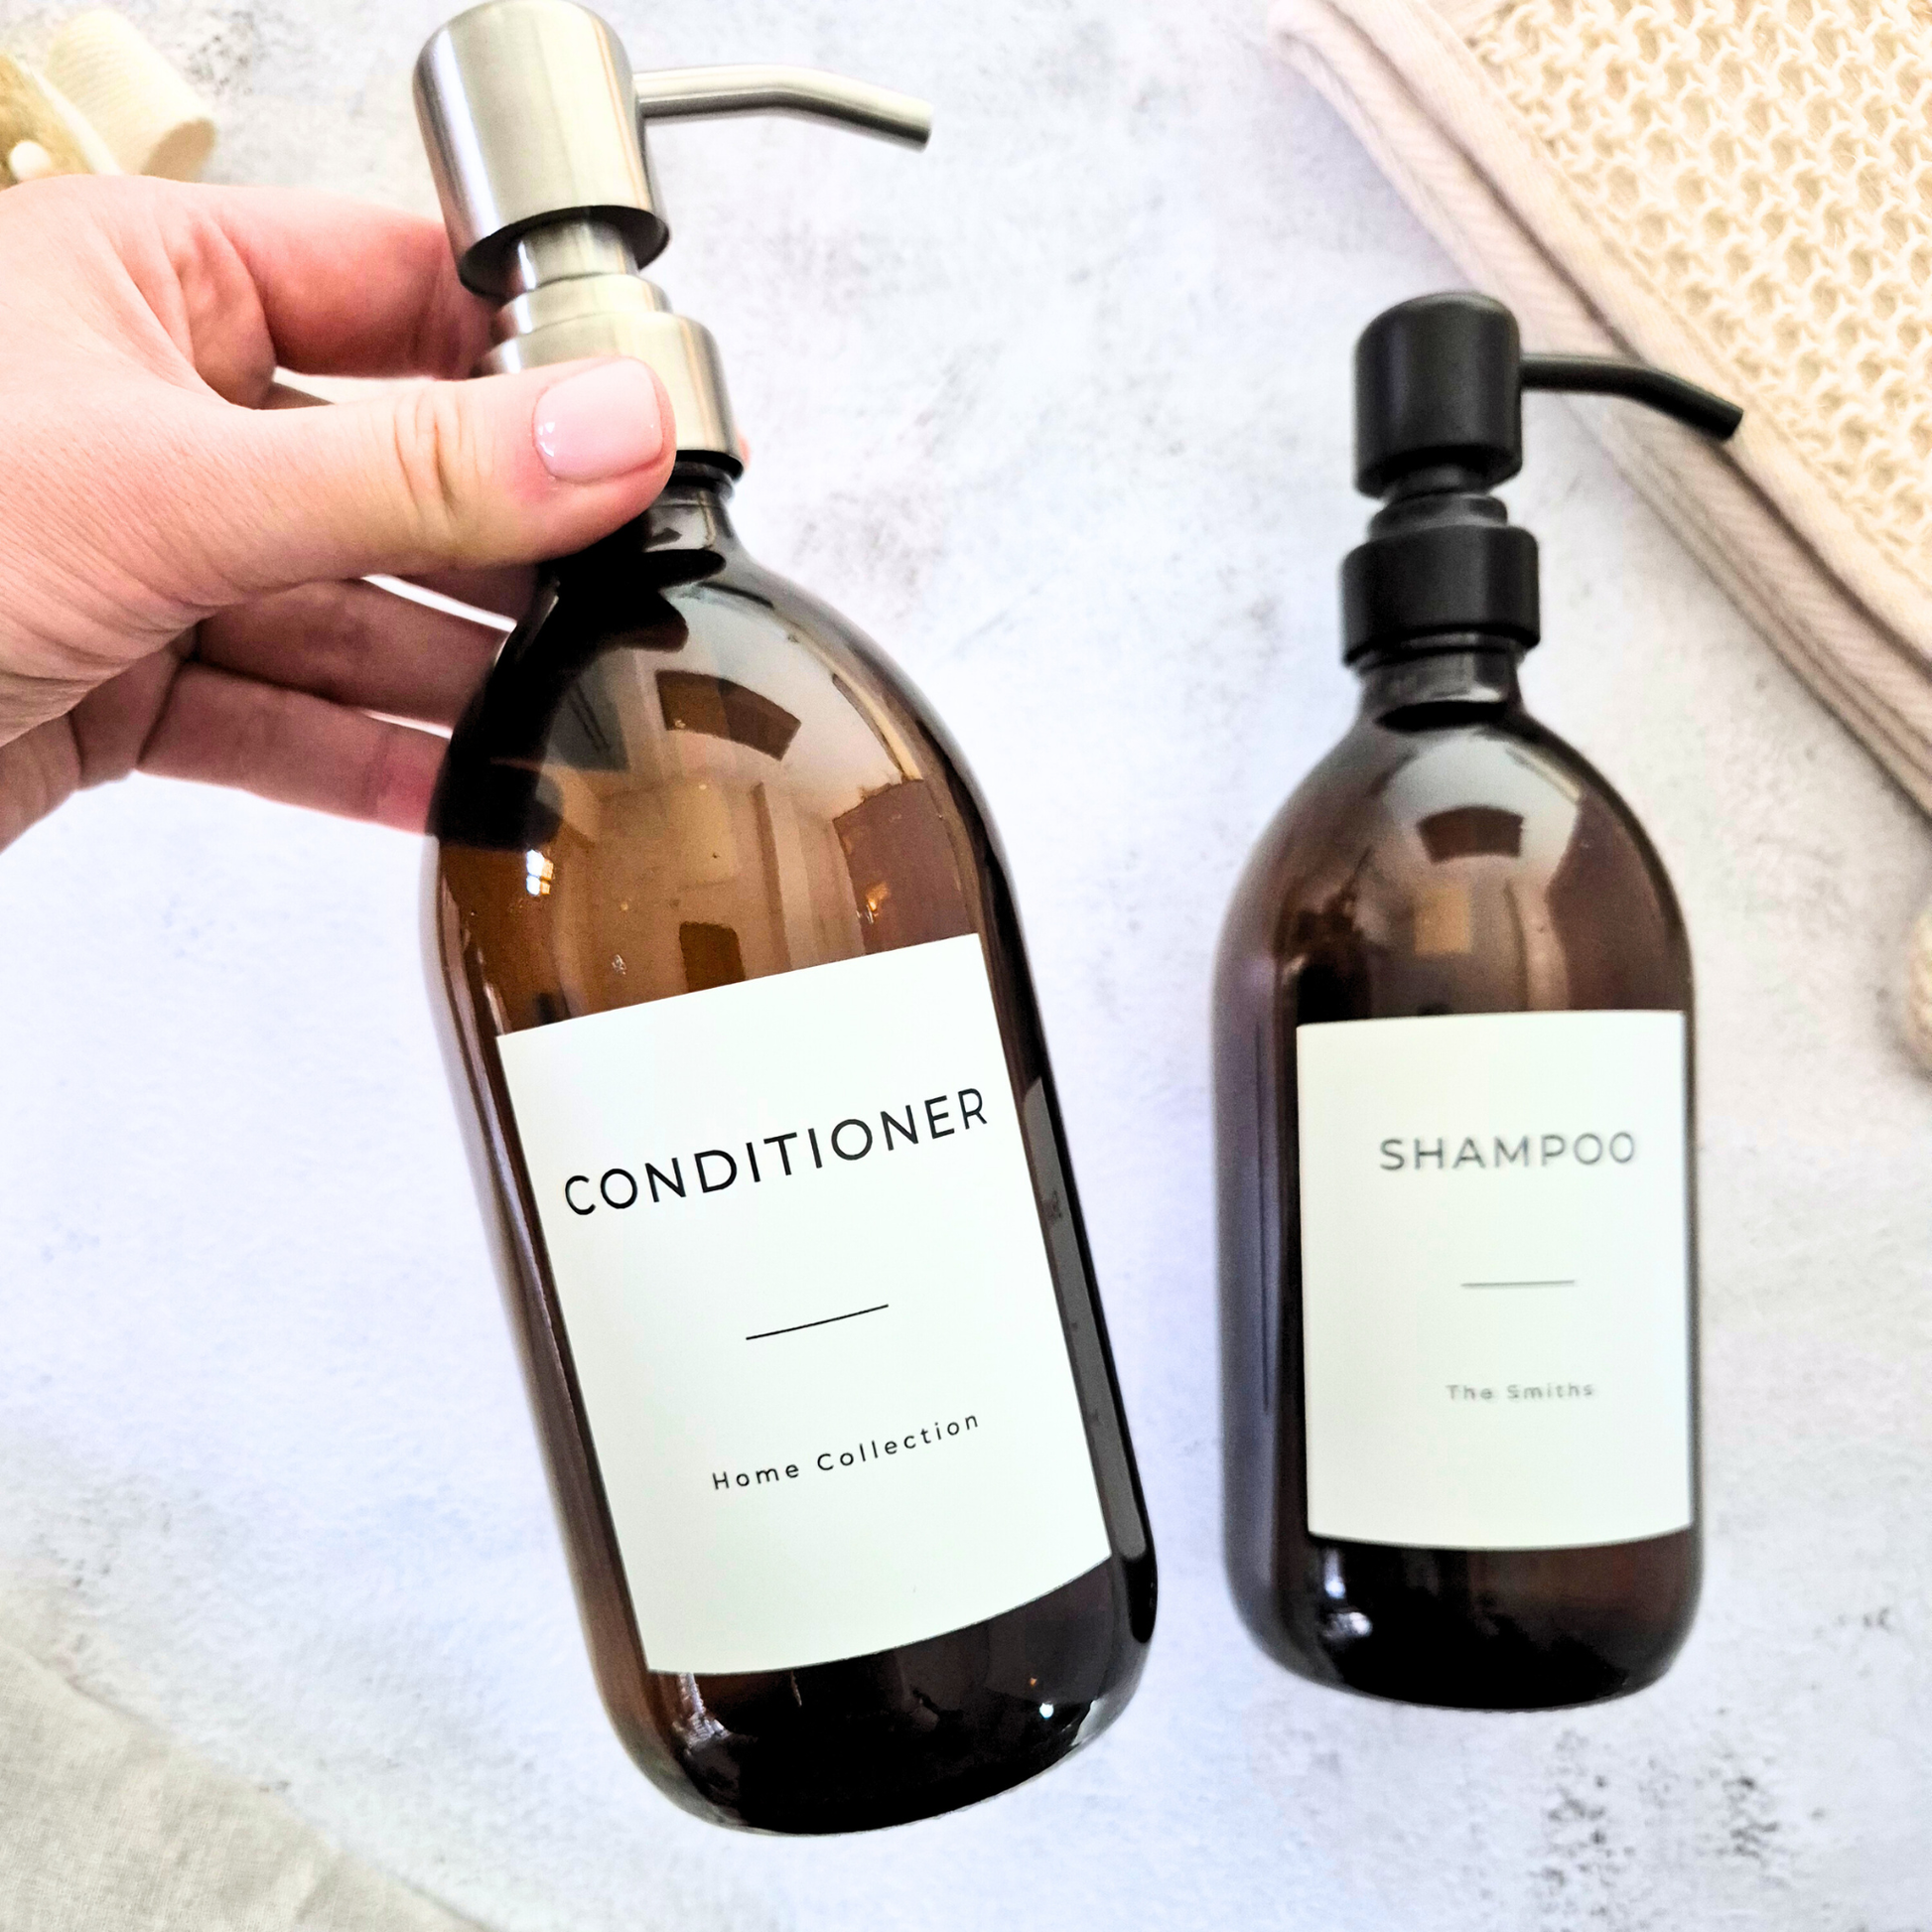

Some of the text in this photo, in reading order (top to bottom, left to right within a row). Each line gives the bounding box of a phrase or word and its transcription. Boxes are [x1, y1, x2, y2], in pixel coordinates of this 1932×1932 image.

[564, 1087, 989, 1217] CONDITIONER
[1379, 1130, 1637, 1173] SHAMPOO
[1447, 1380, 1595, 1402] The Smiths
[712, 1415, 979, 1491] Home Collection
